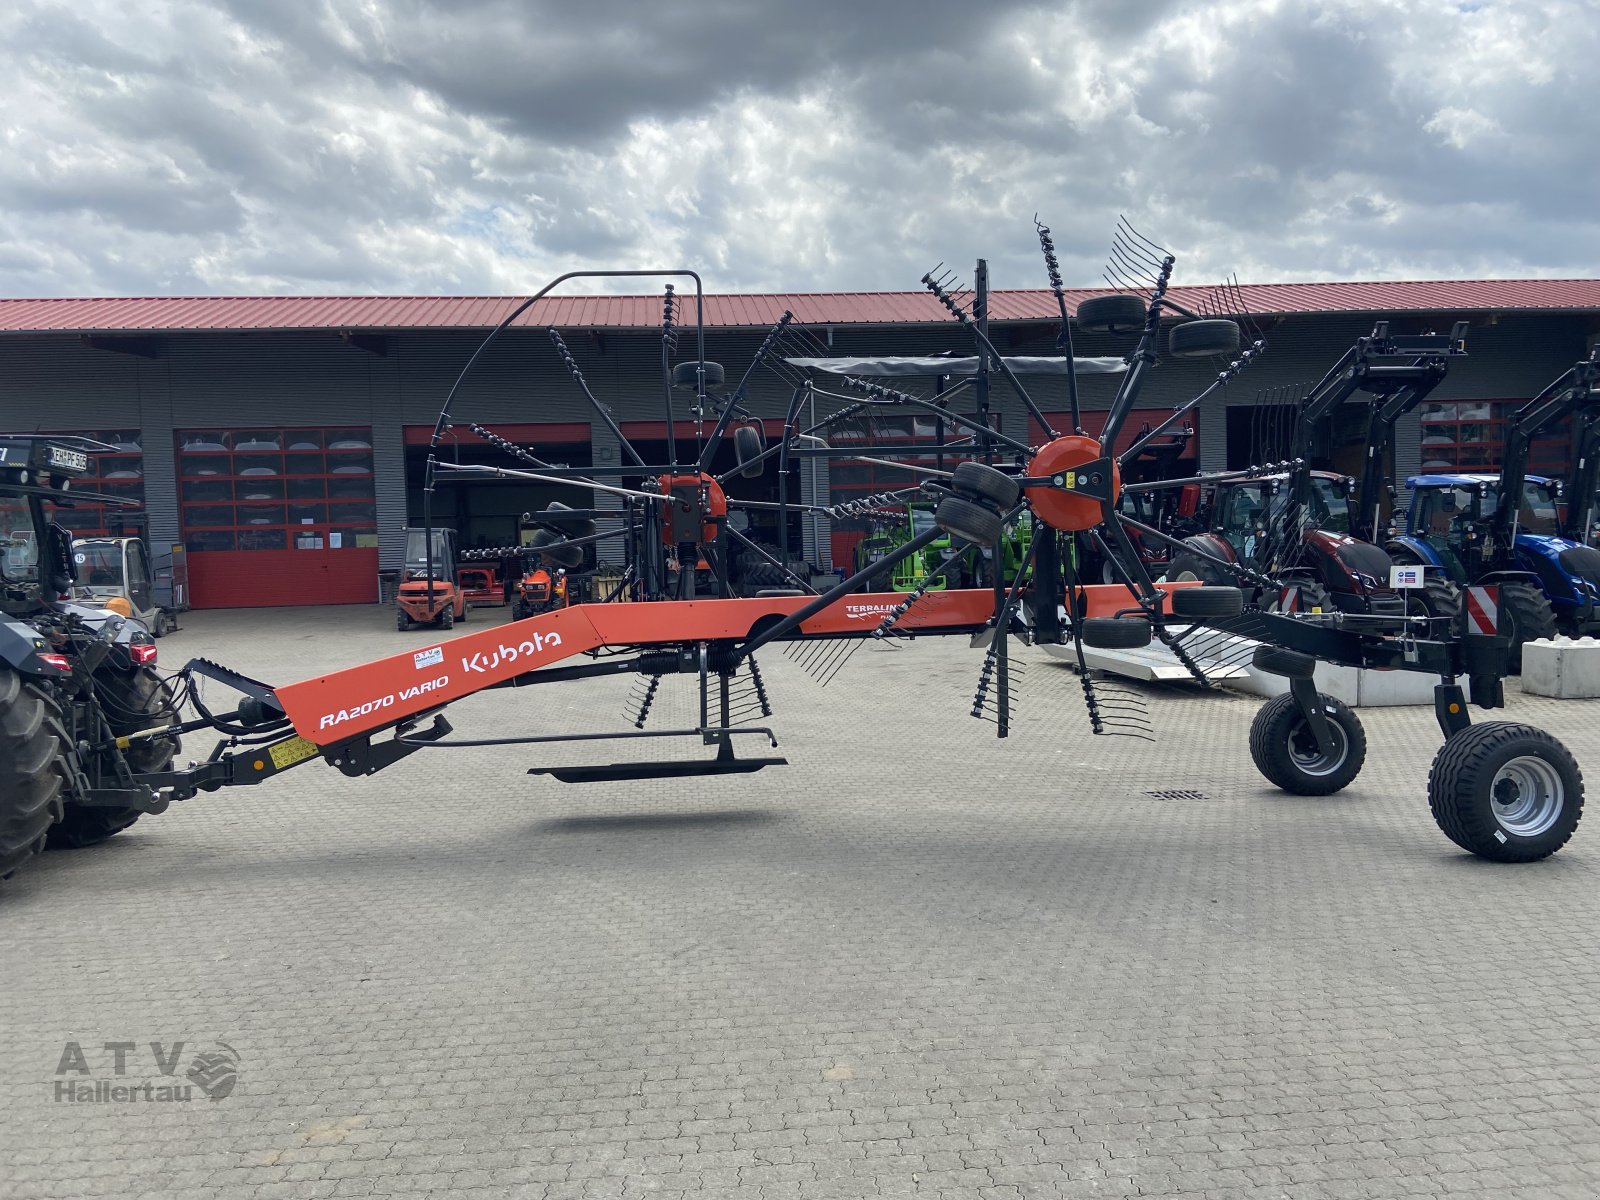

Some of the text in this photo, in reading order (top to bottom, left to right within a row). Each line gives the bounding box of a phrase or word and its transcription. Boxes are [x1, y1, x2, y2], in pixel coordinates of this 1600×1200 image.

[76, 554, 84, 562] 15
[412, 570, 437, 578] Line
[845, 604, 901, 612] TERRALIN
[461, 631, 562, 673] Kubota
[319, 675, 449, 730] RA2070 VARIO
